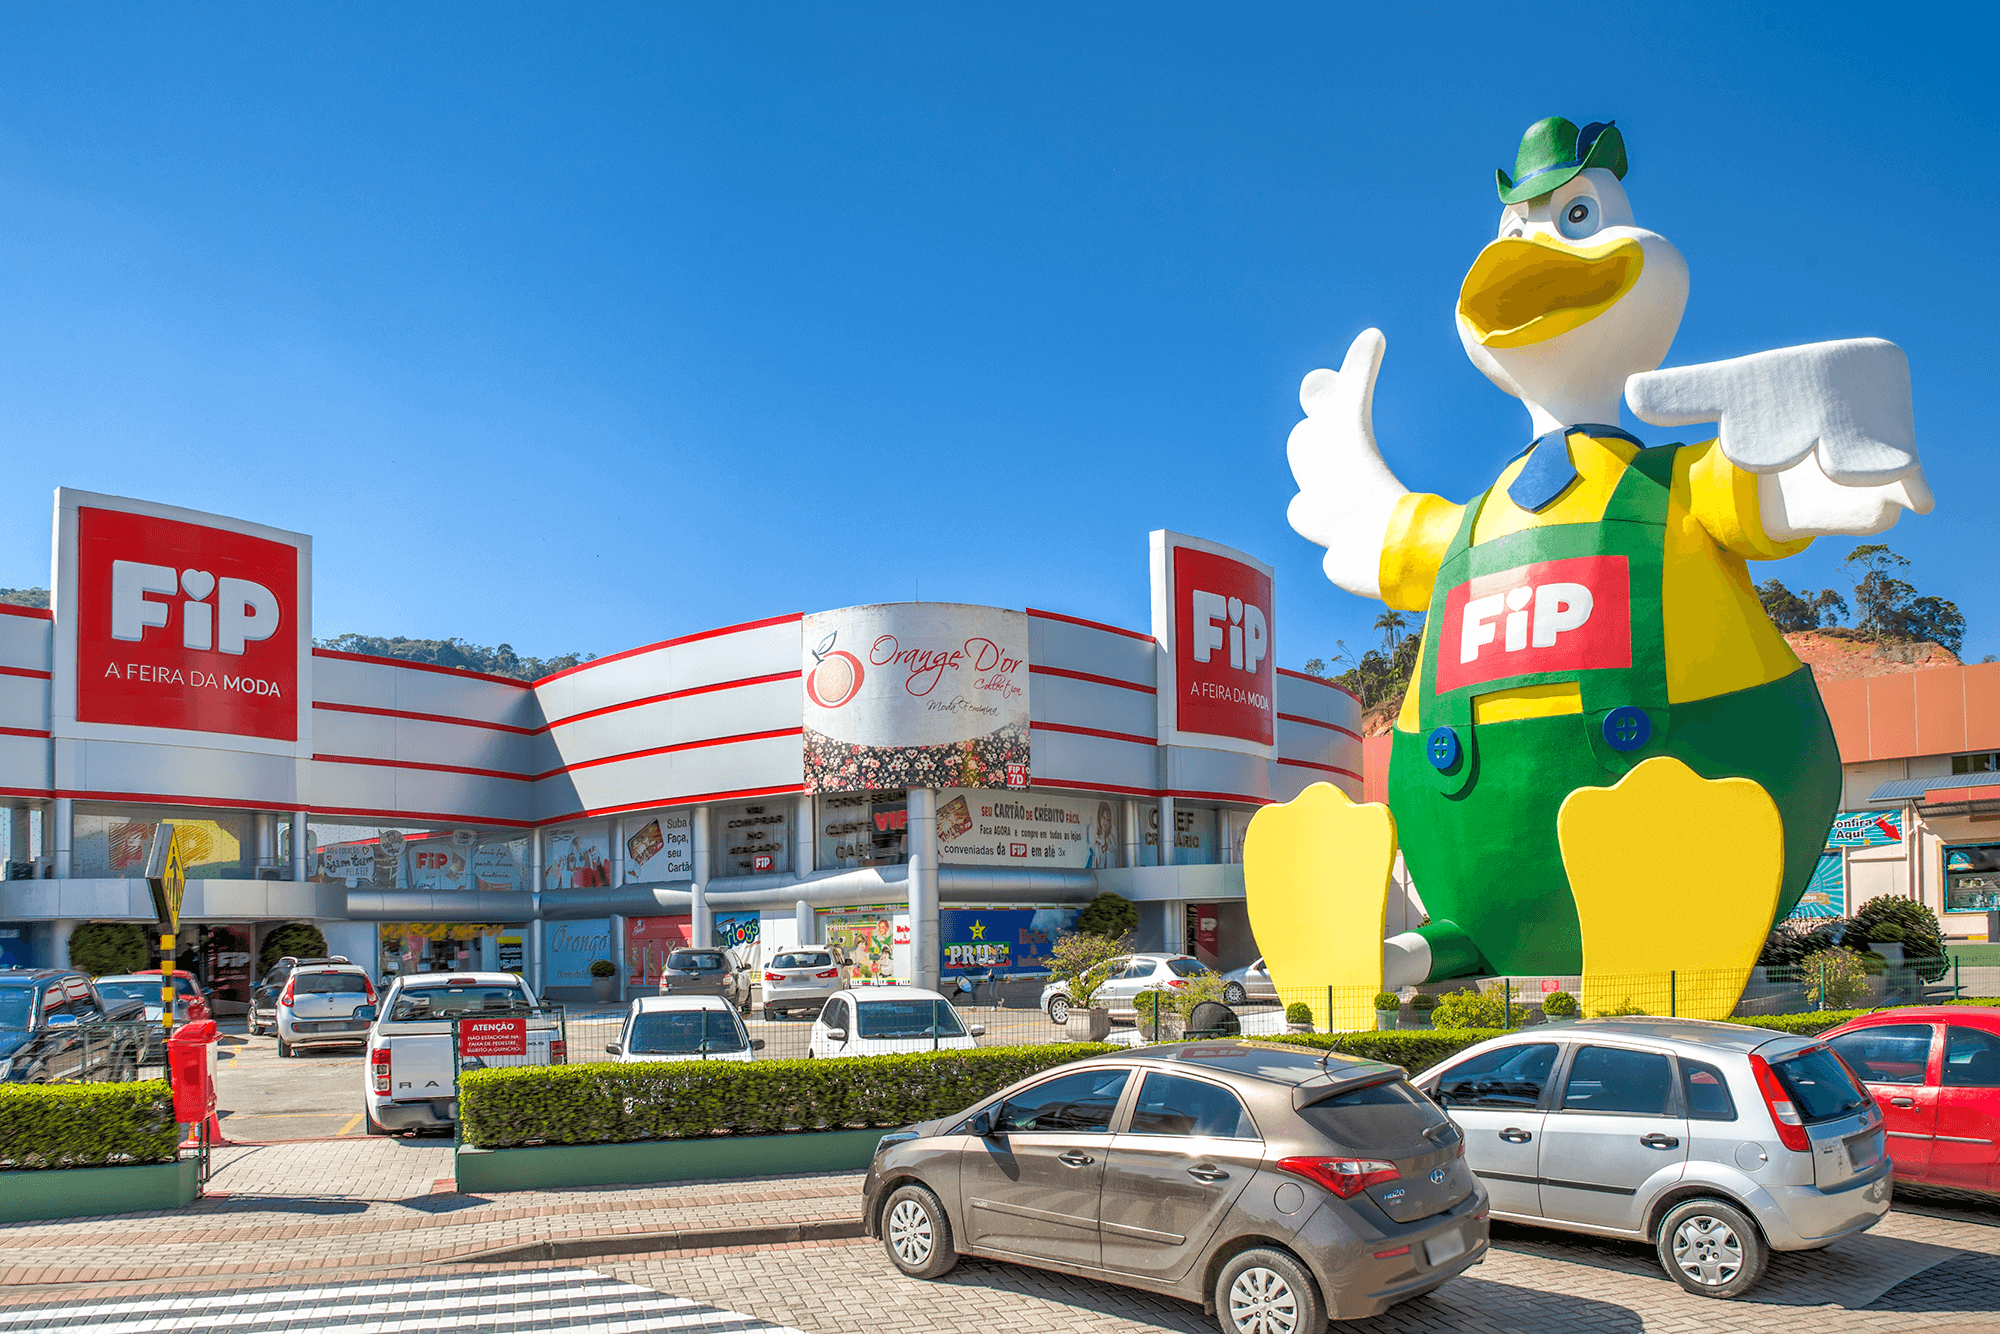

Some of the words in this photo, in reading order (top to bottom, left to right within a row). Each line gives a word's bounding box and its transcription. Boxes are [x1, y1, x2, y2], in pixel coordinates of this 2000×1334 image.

[869, 634, 965, 696] Orange
[965, 637, 1024, 674] D'or
[104, 662, 121, 680] A
[127, 664, 185, 686] FEIRA
[190, 670, 219, 690] DA
[222, 676, 282, 698] MODA
[973, 674, 1023, 699] Collection
[1190, 681, 1200, 696] A
[1203, 682, 1232, 702] FEIRA
[1234, 687, 1247, 704] DA
[1248, 692, 1270, 711] MODA
[926, 695, 964, 714] Moda
[958, 699, 1000, 716] Feminina
[1010, 774, 1024, 785] 7D
[981, 805, 993, 818] SEU
[994, 800, 1025, 821] CARTÃO
[1026, 810, 1033, 821] DE
[1034, 803, 1065, 824] CRÉDITO
[1065, 811, 1081, 824] FÁCIL
[667, 817, 688, 829] Suba
[825, 821, 874, 837] CLIENTE
[873, 810, 908, 831] VIP
[1832, 817, 1873, 829] onfira
[667, 833, 689, 845] Faça,
[980, 824, 992, 838] Faça
[994, 825, 1011, 837] AGORA
[1021, 829, 1039, 840] compre
[1040, 831, 1047, 839] em
[1049, 830, 1062, 840] todas
[1064, 832, 1070, 840] as
[1071, 830, 1082, 842] lojas
[1835, 829, 1865, 841] Aqui
[667, 849, 682, 858] seu
[944, 843, 994, 856] conveniadas
[997, 842, 1006, 856] da
[1031, 846, 1042, 857] em
[1044, 845, 1055, 858] até
[1058, 847, 1066, 857] 3x
[896, 925, 910, 933] Beb
[471, 1021, 515, 1033] ATENÇÃO
